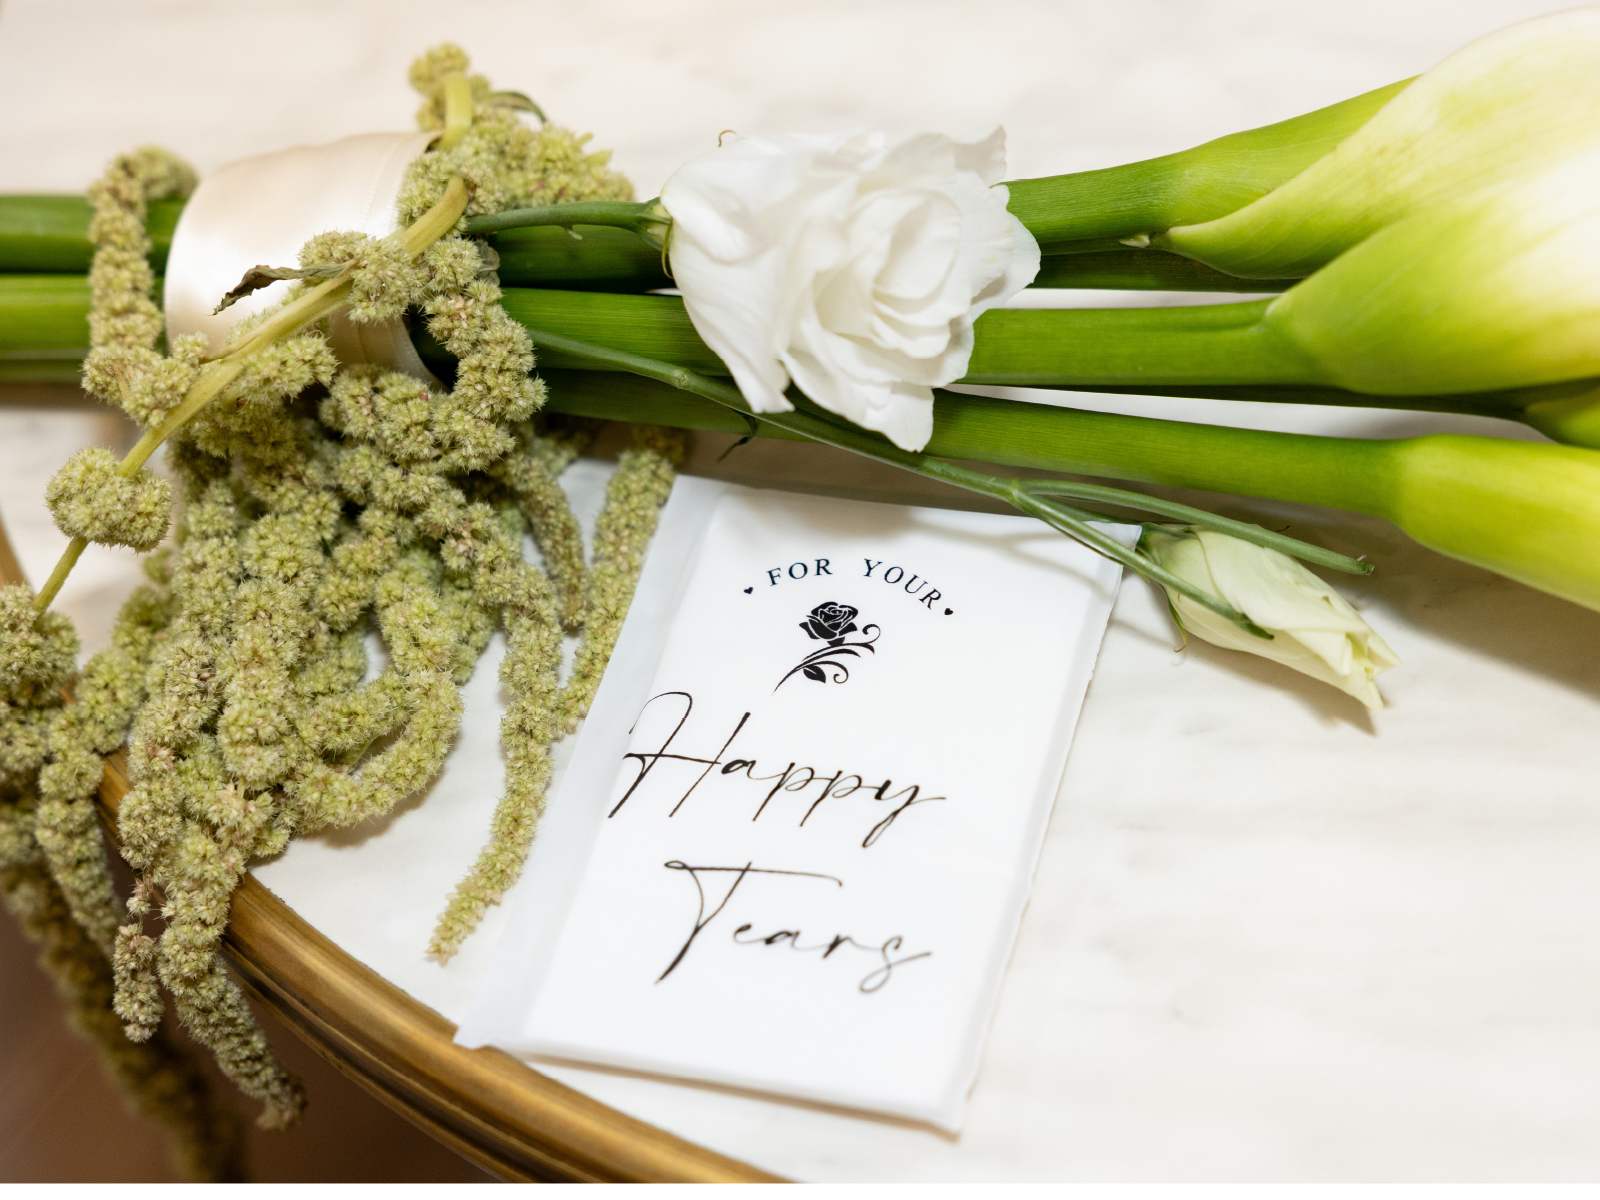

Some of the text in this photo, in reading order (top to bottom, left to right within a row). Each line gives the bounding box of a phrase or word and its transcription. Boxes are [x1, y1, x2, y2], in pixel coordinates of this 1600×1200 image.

[767, 557, 942, 610] FOR YOUR
[608, 691, 946, 848] Happy
[655, 859, 932, 993] Tears
